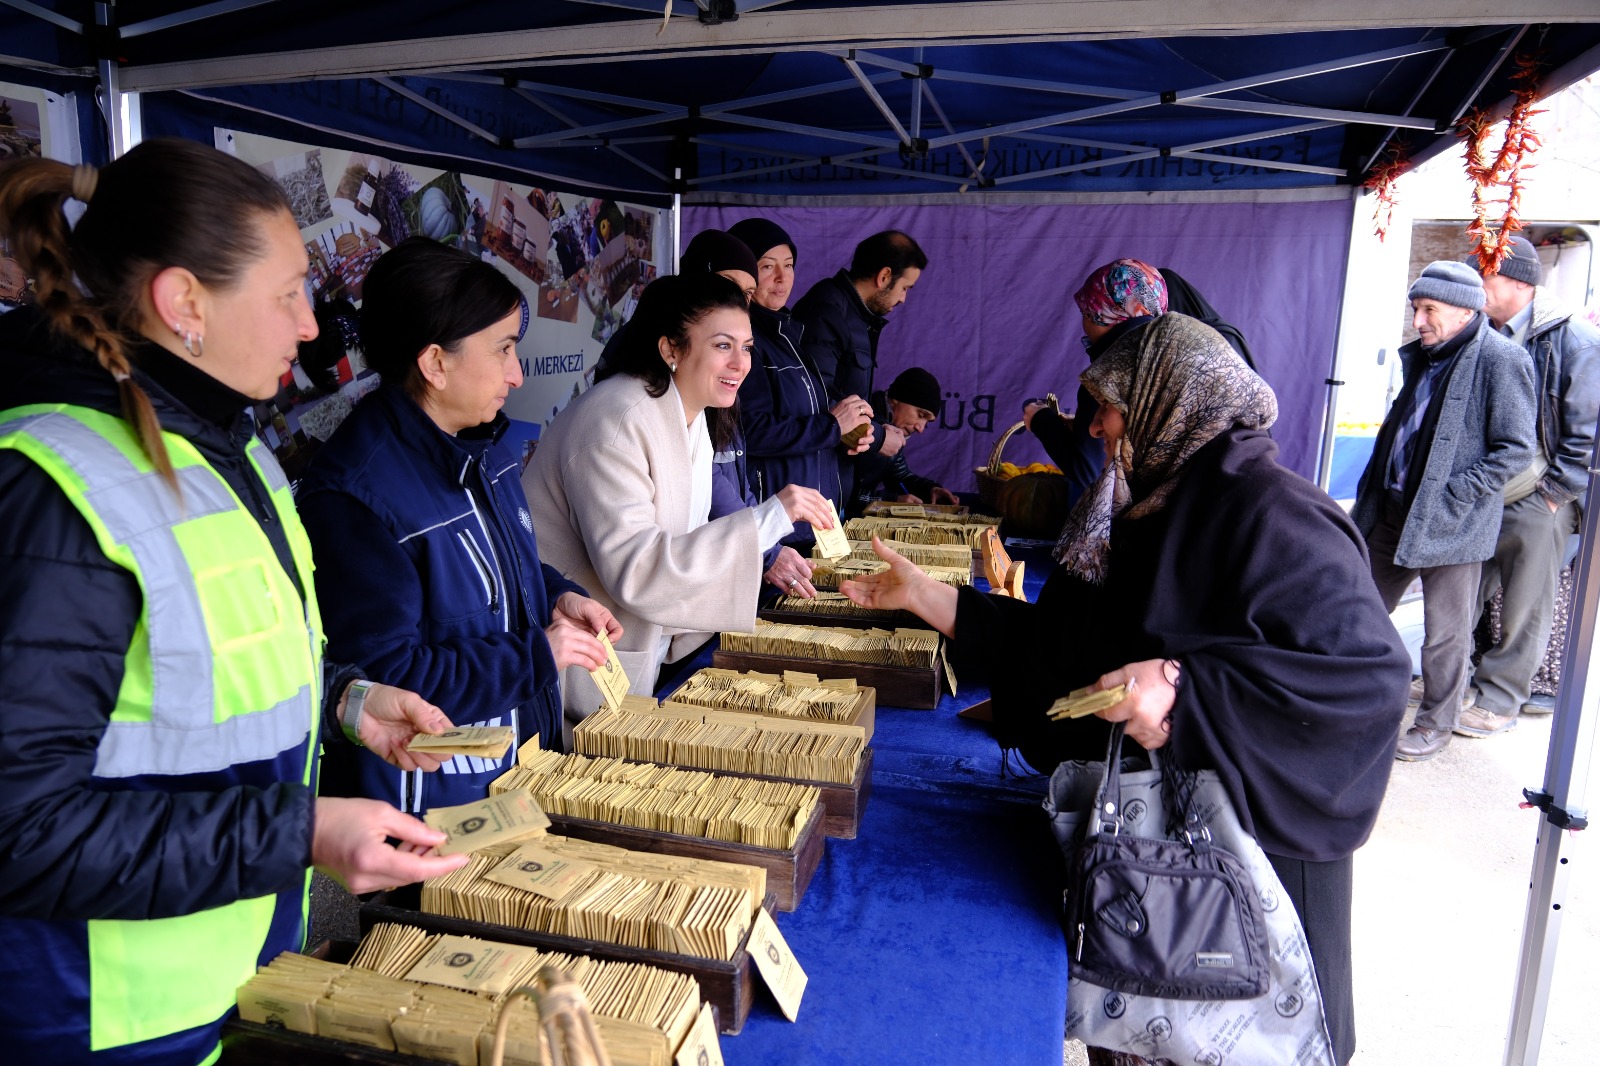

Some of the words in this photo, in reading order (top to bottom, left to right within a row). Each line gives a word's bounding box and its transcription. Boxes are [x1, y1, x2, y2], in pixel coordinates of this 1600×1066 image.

[519, 358, 530, 377] M
[533, 349, 584, 377] MERKEZİ
[1126, 803, 1145, 822] Serta
[1219, 1036, 1229, 1048] THE
